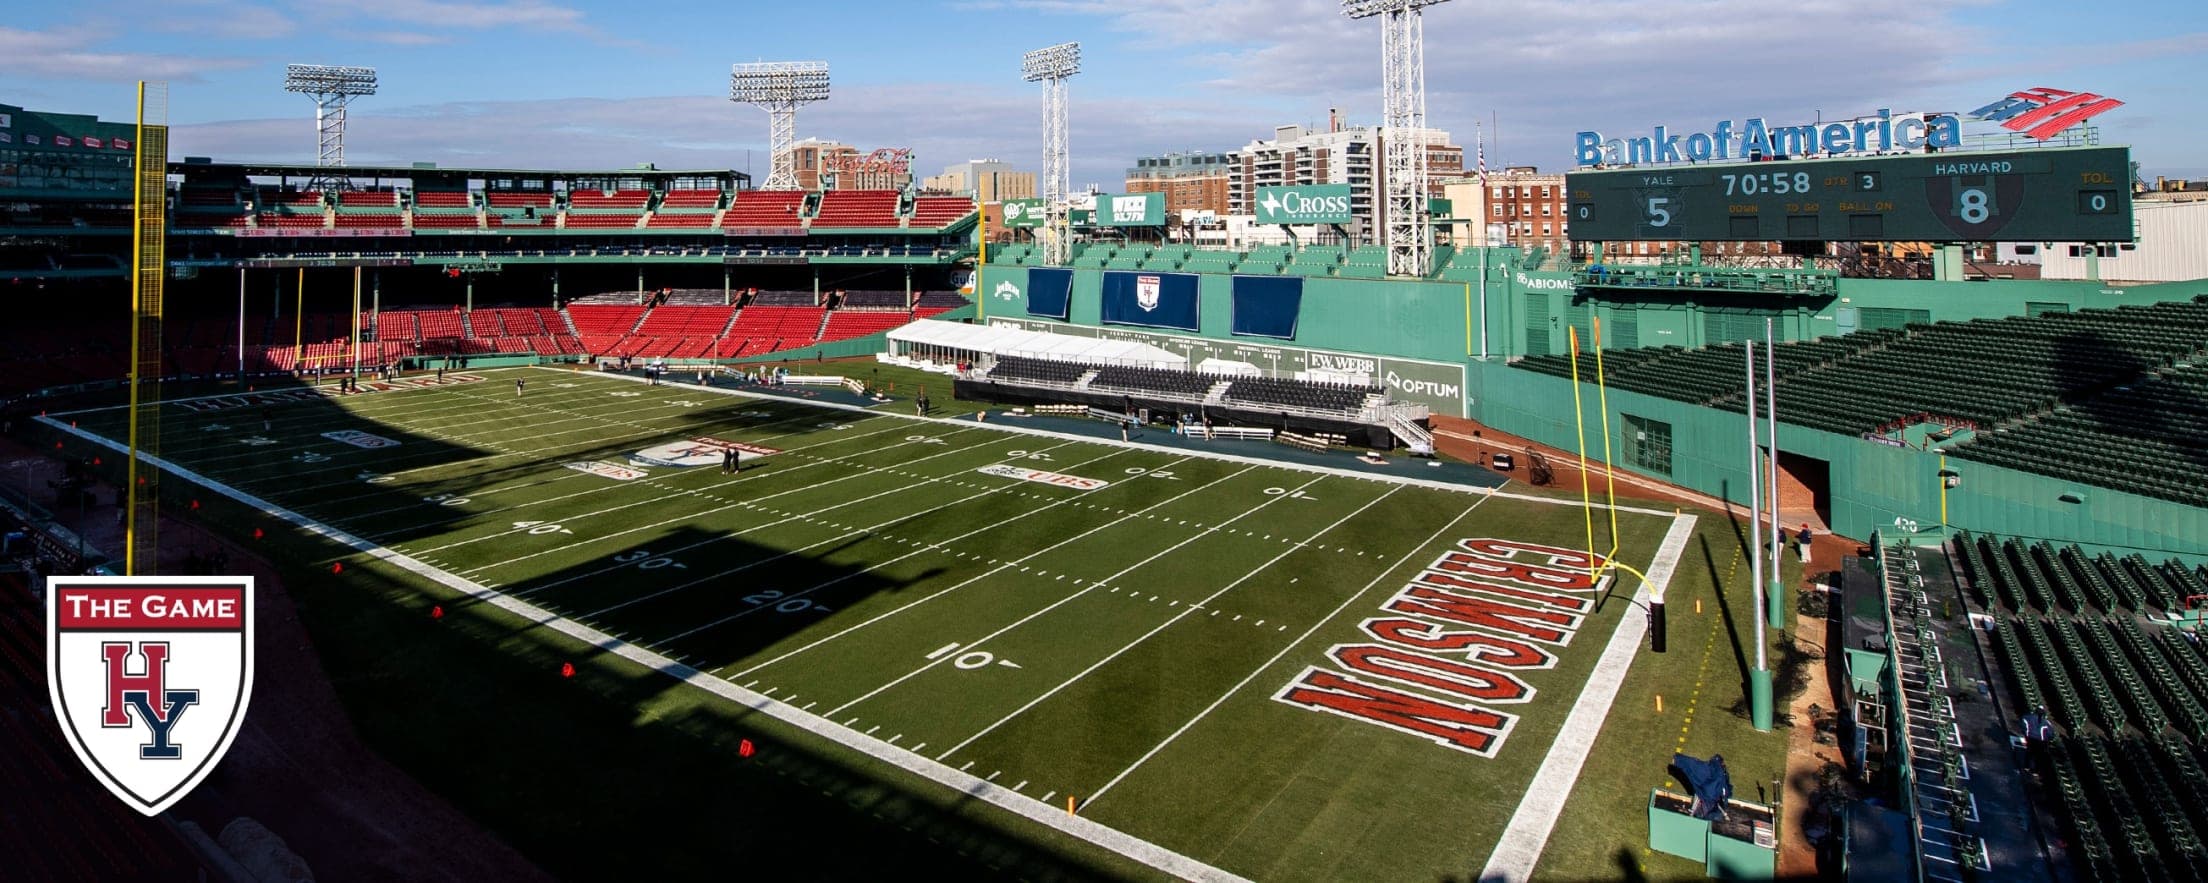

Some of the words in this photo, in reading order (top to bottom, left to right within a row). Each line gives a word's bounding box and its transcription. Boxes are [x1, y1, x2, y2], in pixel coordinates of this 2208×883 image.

[1575, 126, 1682, 167] Bank
[1685, 120, 1734, 161] of
[1738, 108, 1963, 158] America
[1935, 161, 2012, 175] HARVARD
[1643, 176, 1674, 186] YALE
[1721, 172, 1811, 196] 70:58
[1863, 175, 1875, 190] 3
[2081, 173, 2112, 184] TOL
[1282, 192, 1348, 214] CROSS
[1728, 204, 1758, 214] DOWN
[1803, 202, 1820, 212] GO
[1839, 202, 1872, 212] BALL
[1875, 201, 1893, 211] ON
[1960, 189, 1989, 224] 8
[2091, 195, 2106, 211] 0
[1580, 207, 1589, 218] 0
[1648, 198, 1670, 227] 5
[951, 270, 976, 287] Gulf
[1335, 356, 1375, 372] WEBB
[1402, 380, 1459, 398] OPTUM
[1007, 450, 1050, 460] 30
[1028, 472, 1099, 488] UBS
[1125, 467, 1174, 478] 20
[1263, 487, 1307, 498] 10
[512, 520, 562, 535] 40
[1894, 516, 1918, 533] 420
[614, 551, 673, 569] 30
[742, 590, 812, 613] 20
[924, 642, 994, 670] 10
[1270, 537, 1616, 759] CRIMSON
